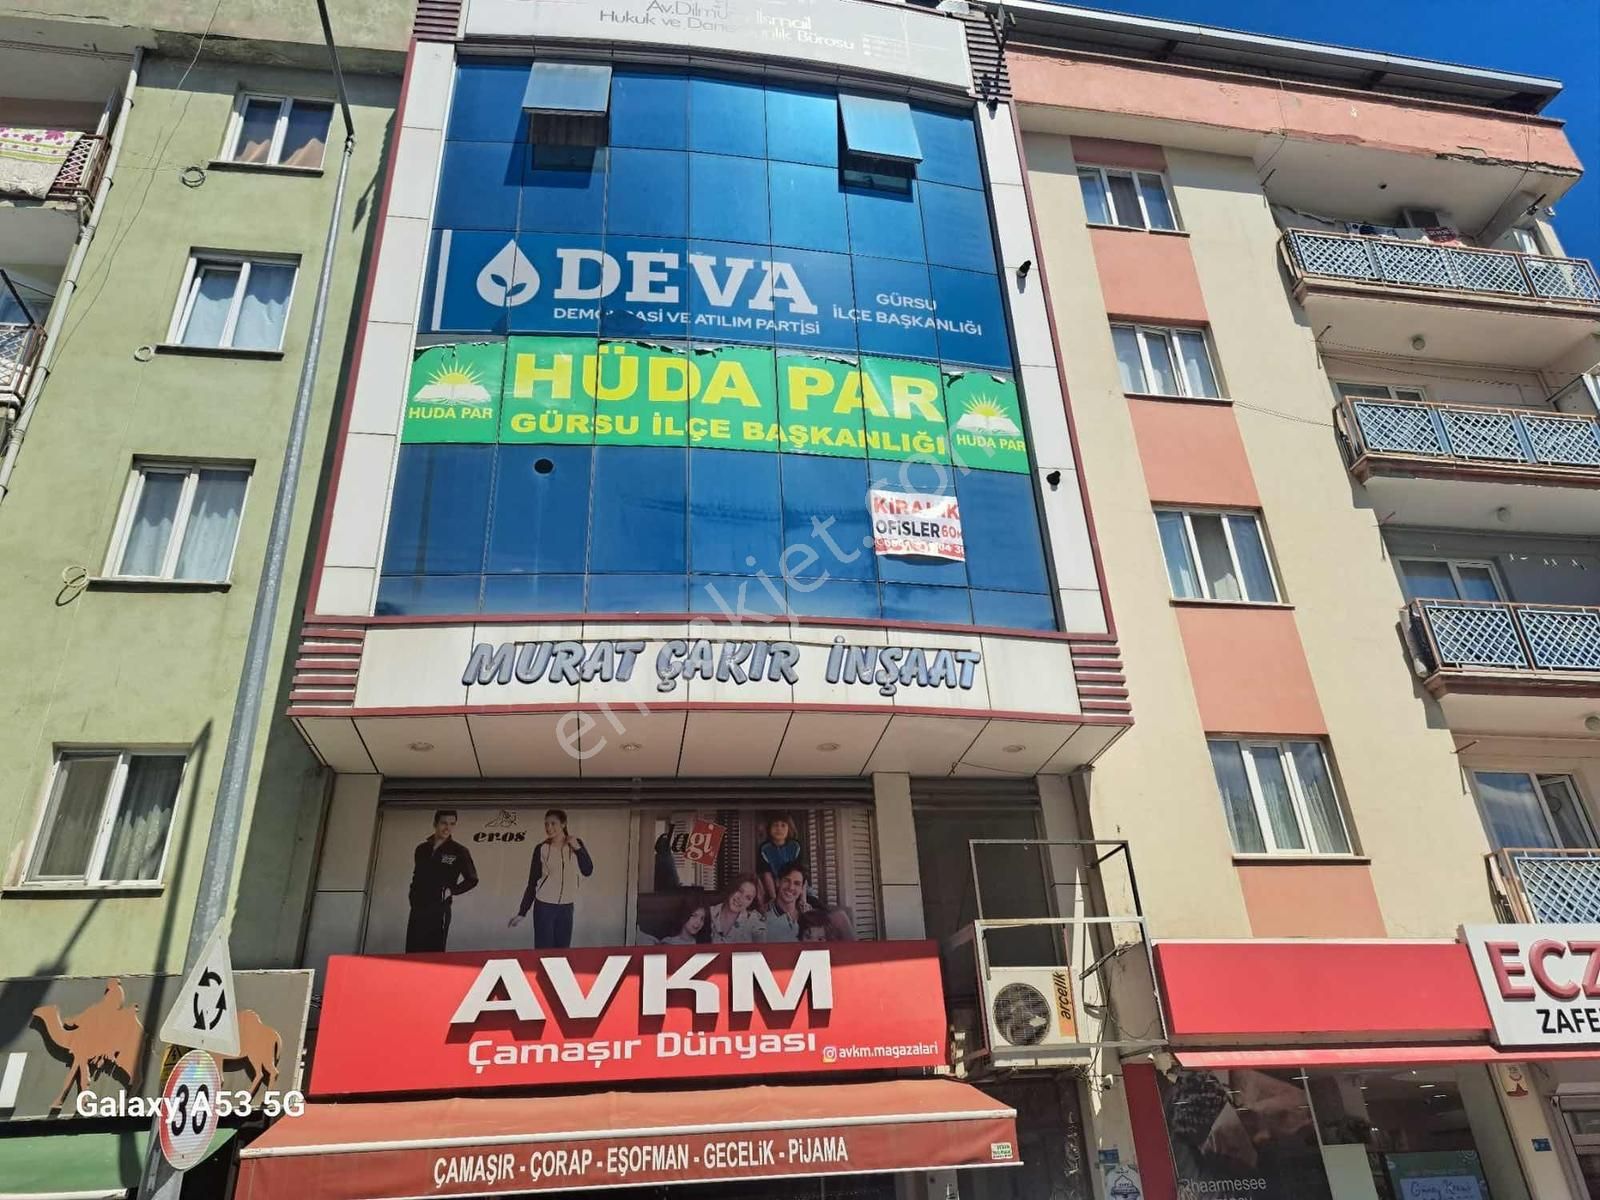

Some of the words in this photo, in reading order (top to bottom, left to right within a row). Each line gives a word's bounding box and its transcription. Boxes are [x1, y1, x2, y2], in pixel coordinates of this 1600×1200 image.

[599, 10, 656, 25] Hukuk
[662, 18, 681, 28] ve
[554, 247, 818, 315] DEVA
[876, 292, 937, 311] GÜRSU
[554, 308, 663, 323] DEMASİ
[667, 311, 691, 324] VE
[695, 313, 752, 328] ATILIM
[756, 318, 820, 335] PARTİSİ
[876, 311, 982, 336] BAŞKANLIĞI
[513, 346, 761, 408] HÜDA
[787, 366, 945, 423] PAR
[461, 407, 493, 419] PAR
[510, 410, 639, 435] GÜRSU
[652, 412, 731, 442] İLÇE
[742, 421, 946, 456] BAŞKANLIĞI
[1000, 438, 1026, 452] PAR
[873, 497, 960, 520] KİRAK
[462, 640, 645, 685] MURAT
[656, 639, 800, 692] ÇAKIR
[825, 636, 981, 695] İNŞAAT
[473, 831, 527, 843] eros
[1485, 938, 1600, 1001] ECZ
[450, 950, 833, 1024] AVKM
[1536, 1008, 1600, 1034] ZAFE
[468, 1038, 641, 1074] Çamaşır
[656, 1031, 816, 1060] Dünyası
[839, 1041, 938, 1059] avkm.magazalari
[171, 1084, 209, 1136] 30
[434, 1153, 514, 1188] ÇAMAŞIR
[530, 1149, 591, 1182] ÇORAP
[607, 1144, 689, 1174] EŞOFMAN
